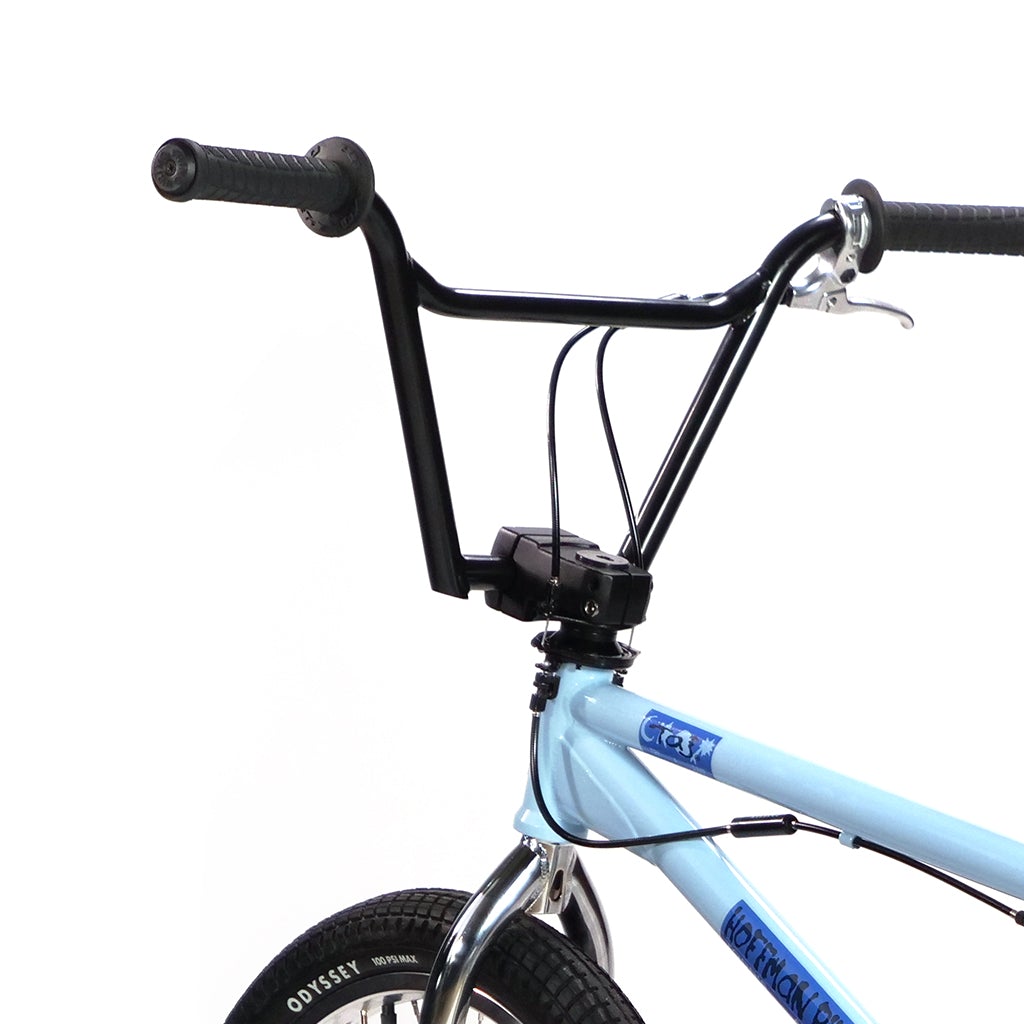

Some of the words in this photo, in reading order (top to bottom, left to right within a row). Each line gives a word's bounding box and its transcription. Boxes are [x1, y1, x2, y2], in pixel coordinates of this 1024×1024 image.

[286, 960, 361, 1013] ODYSSEY
[371, 956, 387, 966] 100
[385, 955, 400, 964] PSI
[398, 954, 418, 964] MAX
